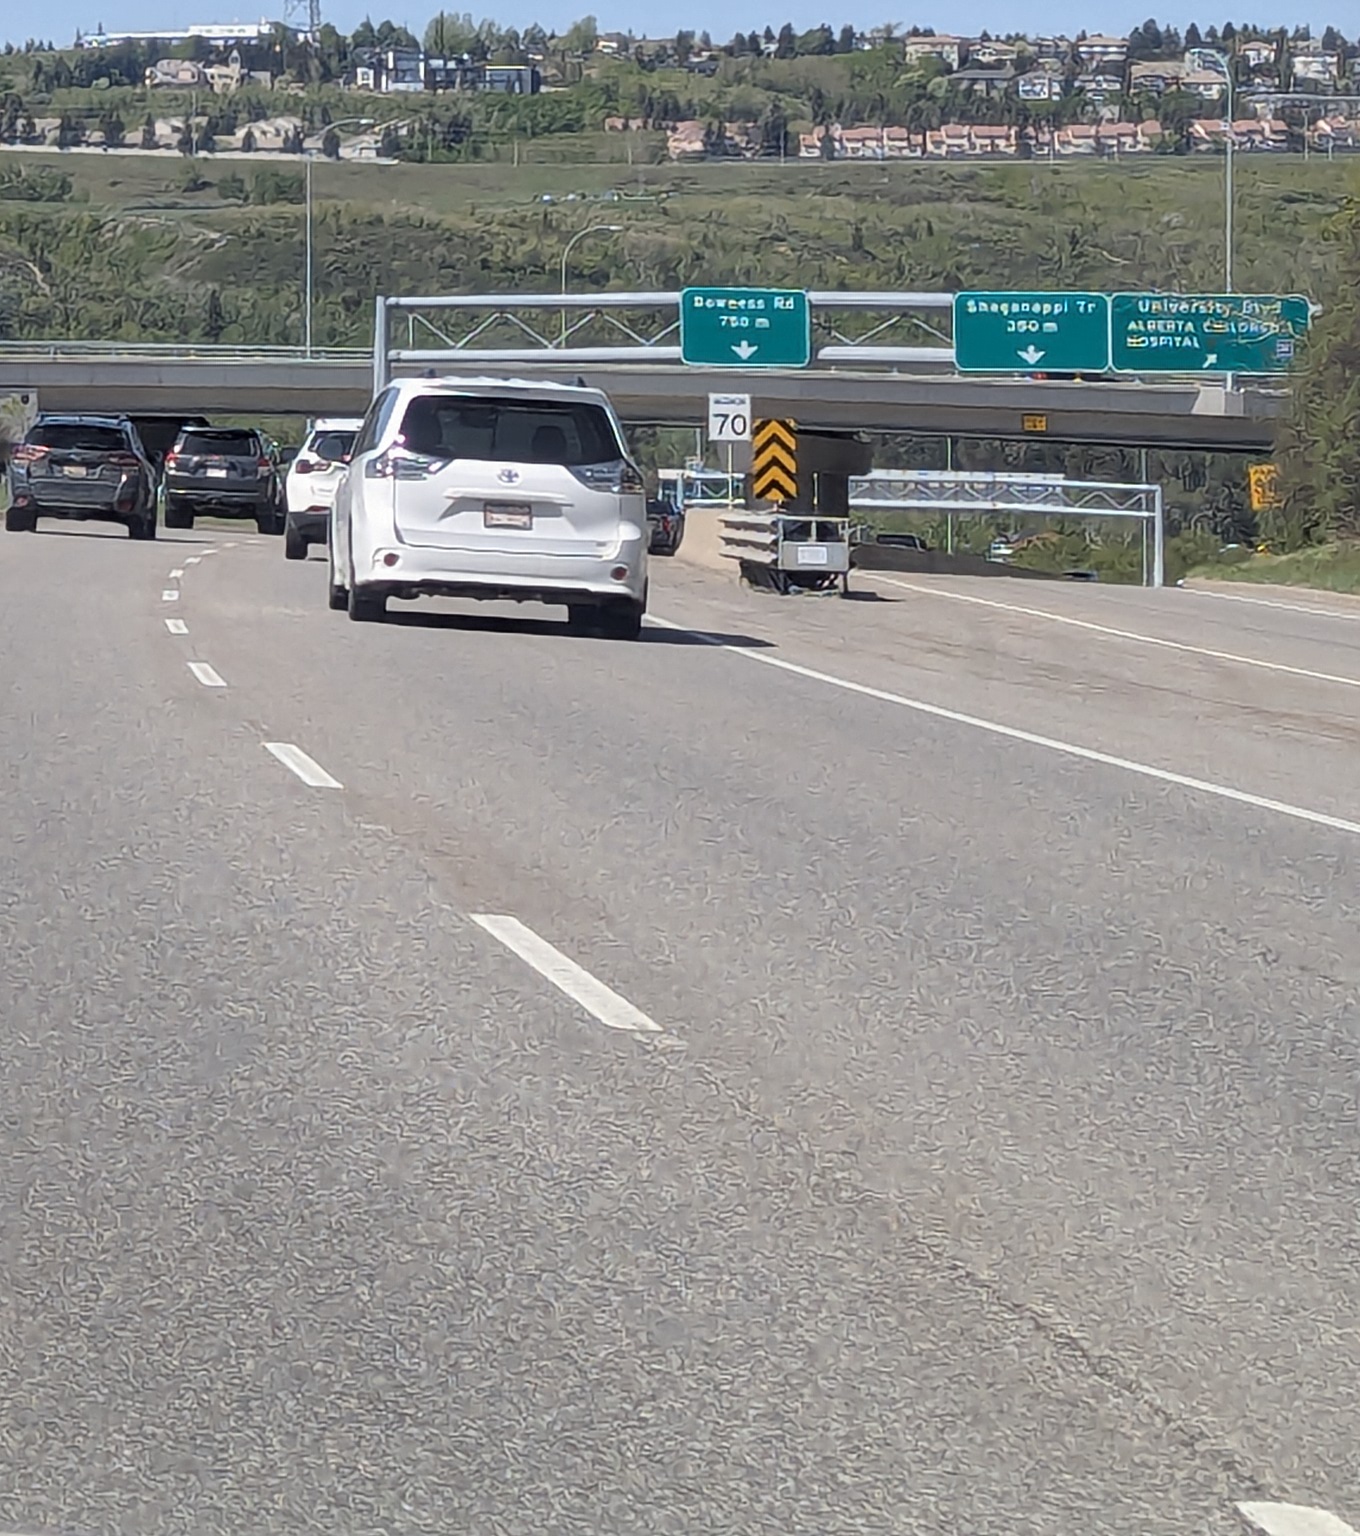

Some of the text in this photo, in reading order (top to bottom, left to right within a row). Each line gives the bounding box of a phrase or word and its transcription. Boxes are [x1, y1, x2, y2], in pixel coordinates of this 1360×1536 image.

[693, 295, 795, 310] Bowness Rd
[965, 299, 1097, 316] Shaganappi Tr
[1137, 298, 1282, 317] University Blvd
[718, 315, 771, 329] 750 m
[1041, 321, 1059, 333] m
[1126, 319, 1196, 333] ALBERTA
[712, 413, 747, 436] 70
